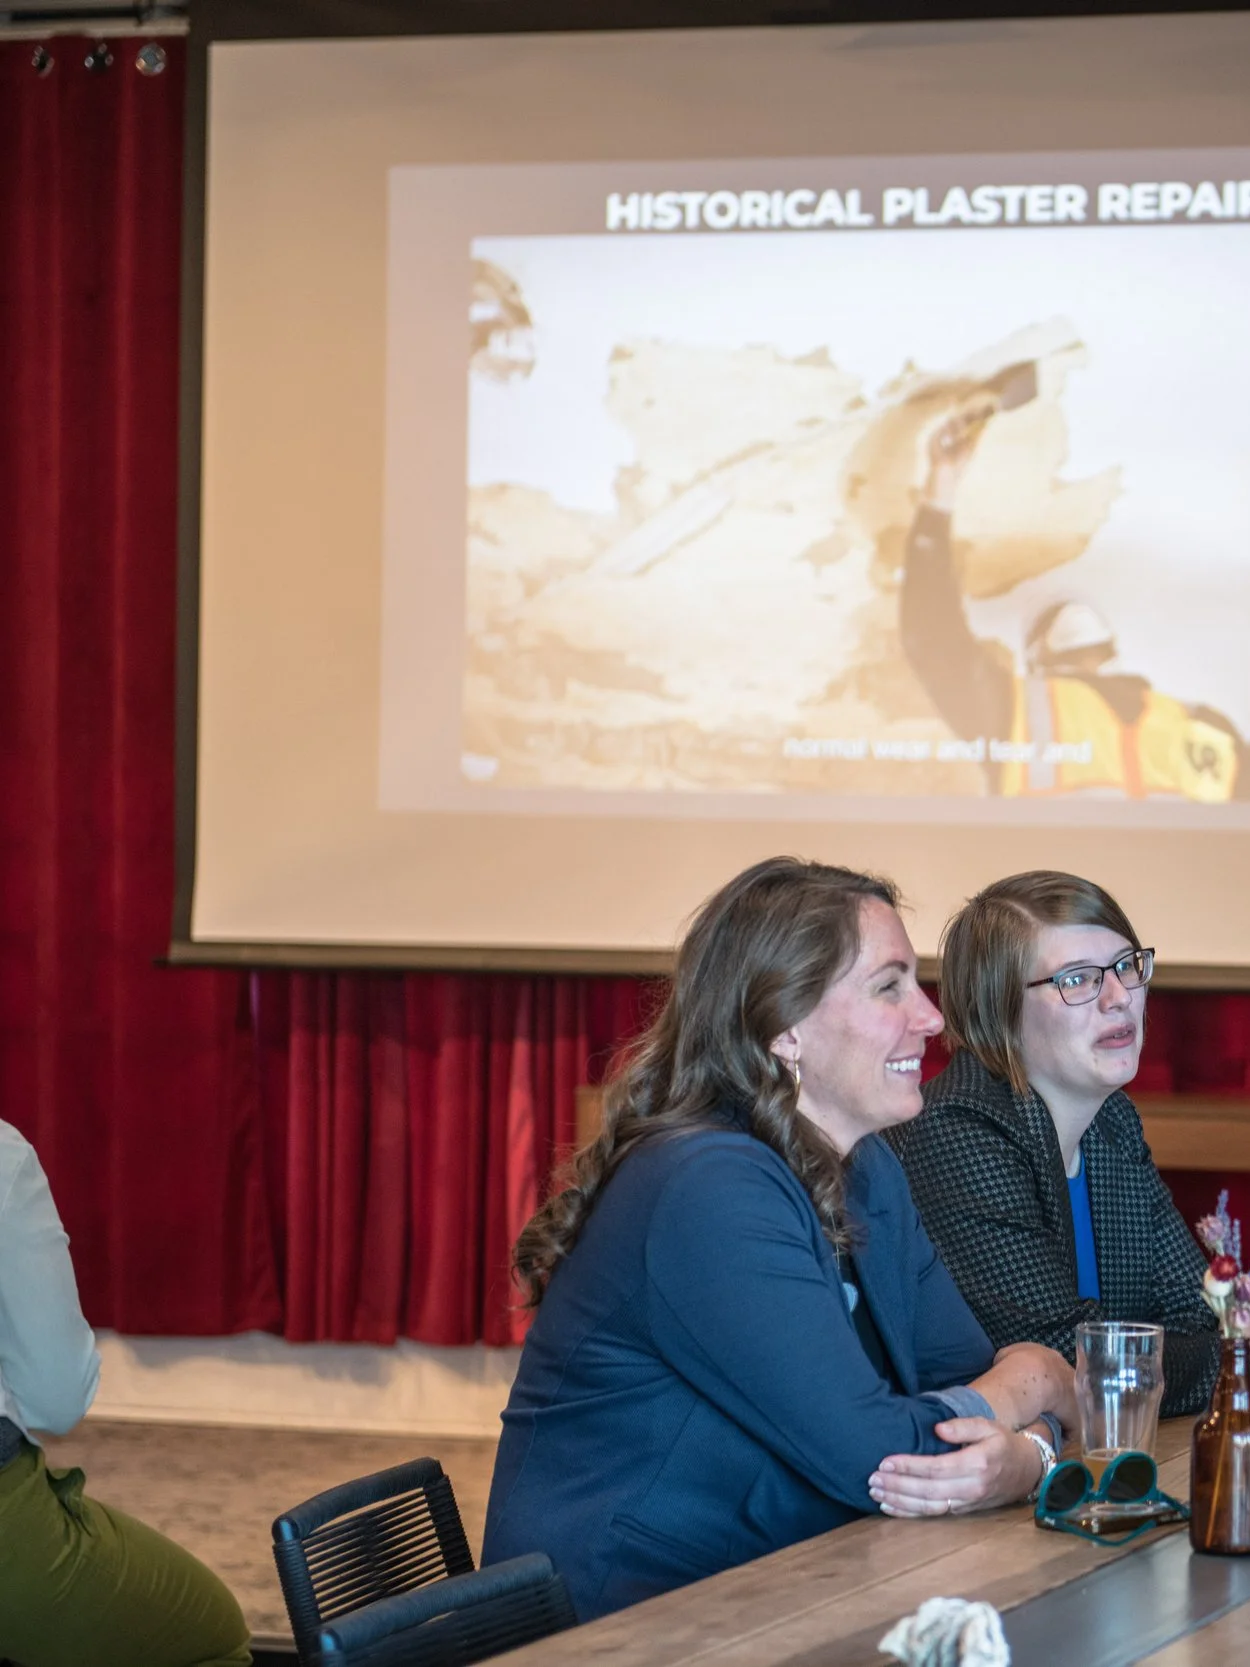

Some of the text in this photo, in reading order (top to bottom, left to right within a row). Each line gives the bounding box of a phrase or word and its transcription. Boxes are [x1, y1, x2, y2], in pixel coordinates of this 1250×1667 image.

[605, 188, 875, 231] HISTORICAL
[882, 184, 1088, 226] PLASTER
[783, 736, 868, 760] normal
[872, 739, 931, 762] wear
[936, 735, 985, 763] and
[1040, 739, 1093, 765] and
